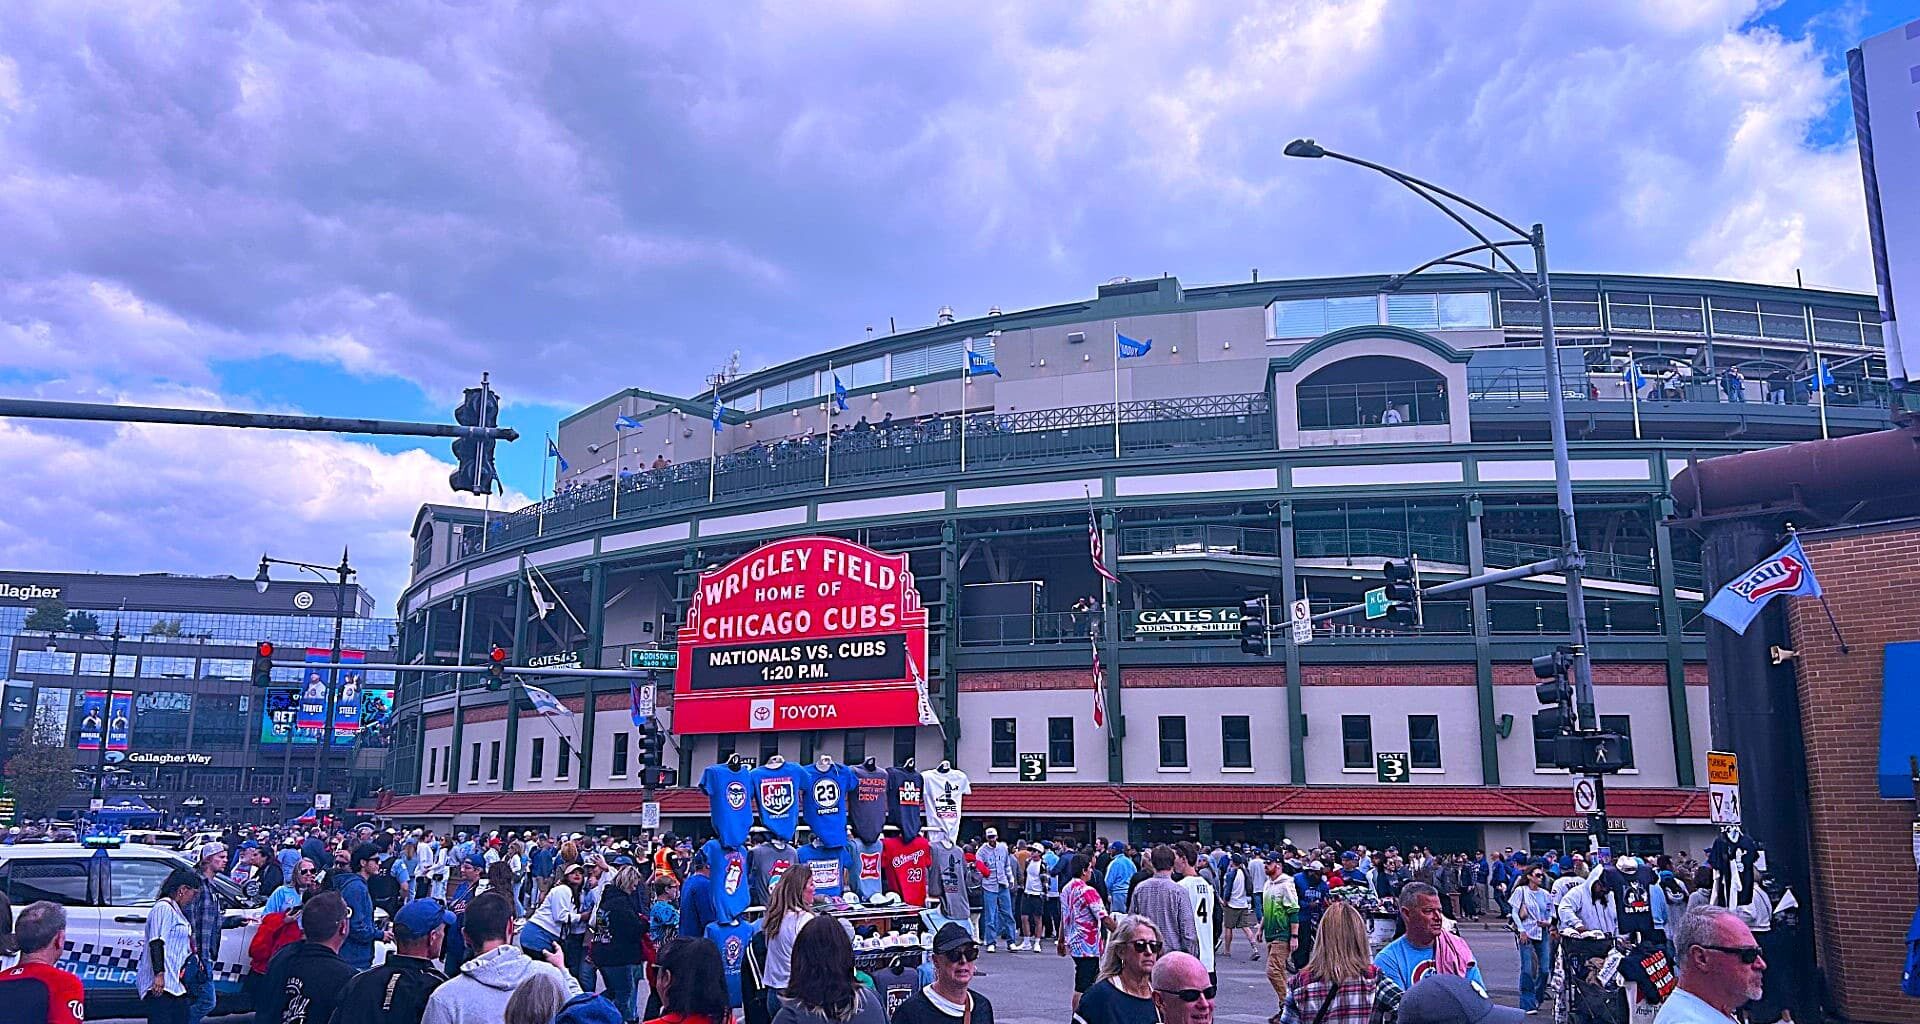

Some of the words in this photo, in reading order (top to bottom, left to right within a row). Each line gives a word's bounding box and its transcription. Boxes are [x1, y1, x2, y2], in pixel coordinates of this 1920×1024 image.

[705, 547, 812, 606] WRIGLEY
[823, 548, 896, 591] FIELD
[755, 584, 805, 602] HOME
[818, 581, 842, 597] OF
[703, 608, 811, 640] CHICAGO
[823, 604, 896, 631] CUBS
[1140, 610, 1213, 623] GATES
[1218, 609, 1227, 621] 1
[1140, 624, 1187, 632] ADDISON
[528, 655, 560, 667] GATES
[570, 651, 578, 662] 5
[640, 652, 669, 660] ADDISON
[709, 646, 801, 667] NATIONALS
[806, 644, 833, 660] VS.
[838, 641, 886, 658] CUBS
[761, 665, 793, 681] 1:20
[798, 663, 829, 679] P.M.
[339, 706, 357, 715] STEELE
[780, 704, 837, 719] TOYOTA
[129, 753, 186, 765] Gallagher
[186, 753, 212, 765] Way
[1024, 760, 1042, 776] 3
[1383, 760, 1403, 777] 3
[816, 784, 837, 802] 23
[904, 781, 916, 791] DA
[764, 796, 791, 810] Style
[900, 791, 920, 801] POPE
[907, 868, 922, 883] 23
[1197, 898, 1207, 923] 4
[83, 964, 137, 984] POLIC
